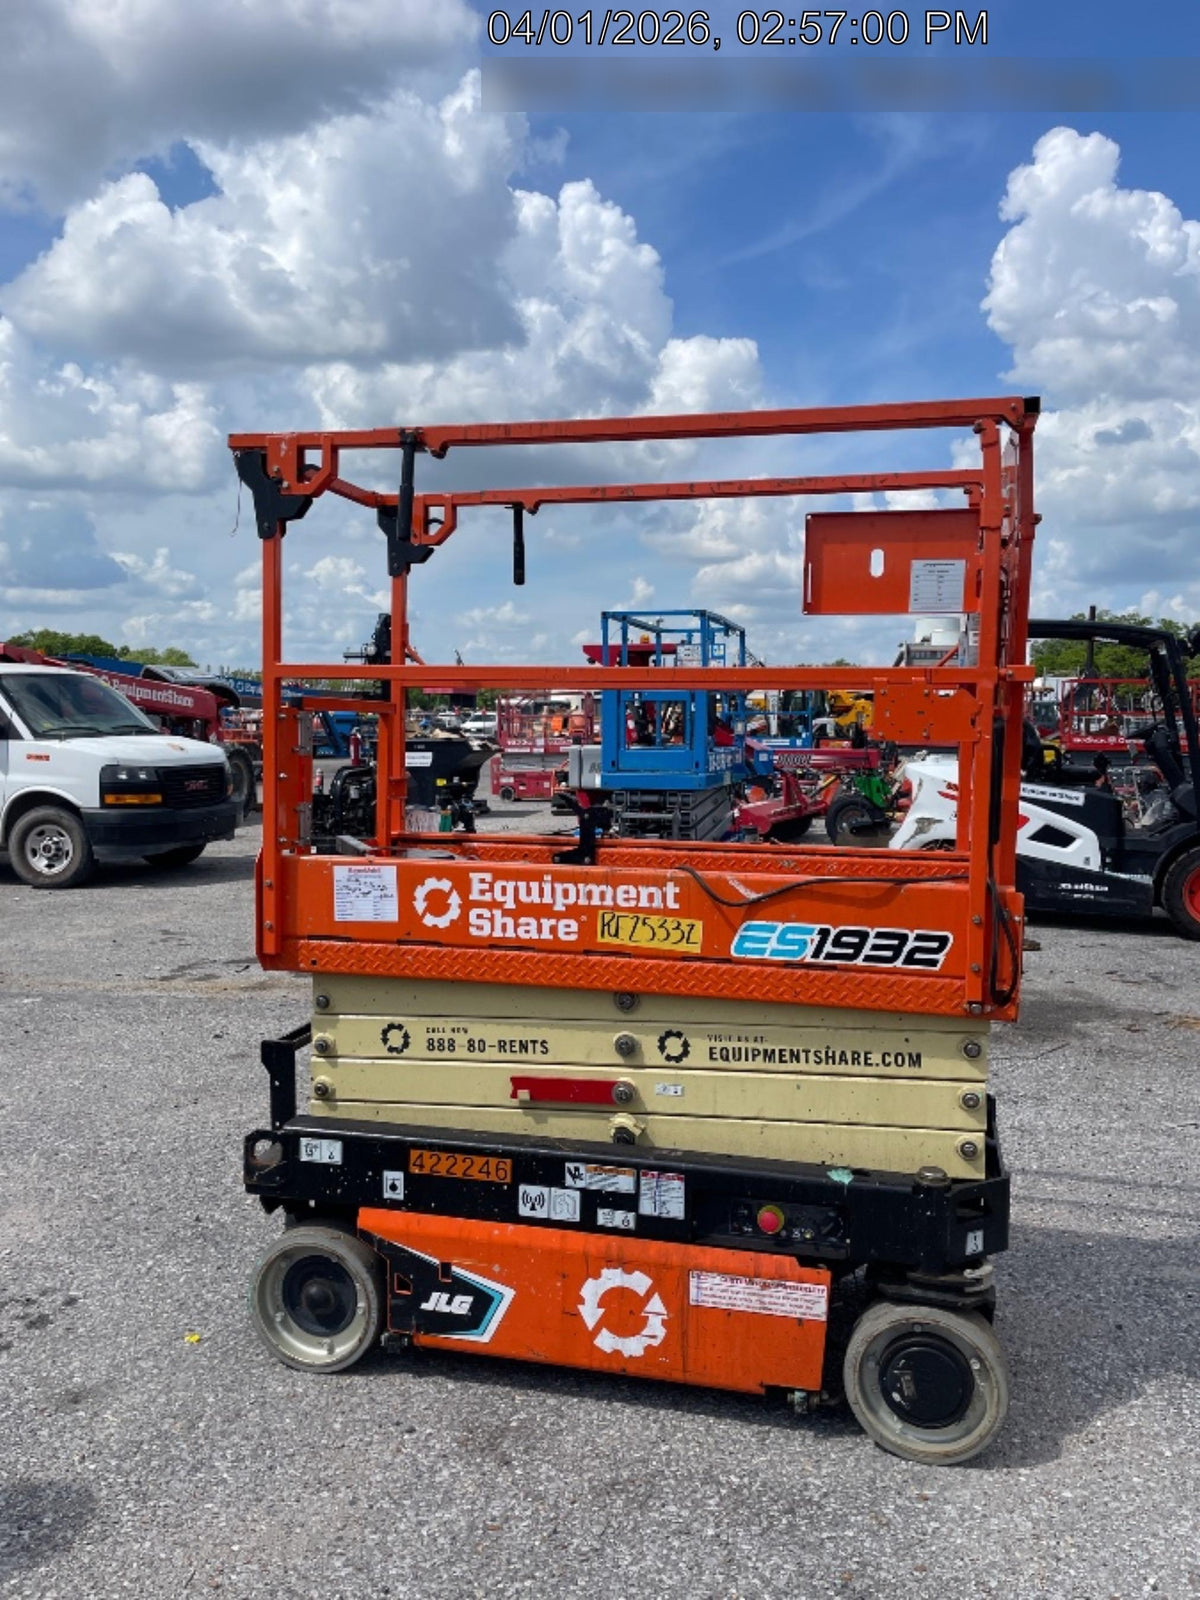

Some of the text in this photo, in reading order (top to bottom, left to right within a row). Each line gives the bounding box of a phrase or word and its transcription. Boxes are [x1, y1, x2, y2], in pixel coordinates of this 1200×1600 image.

[469, 872, 680, 911] Equipment
[469, 908, 579, 941] Share
[732, 922, 952, 969] ES1932
[426, 1037, 549, 1055] 888-80-RENTS
[709, 1046, 922, 1069] EQUIPMENTSHARE.COM
[412, 1153, 508, 1181] 422246
[420, 1291, 474, 1315] JLG
